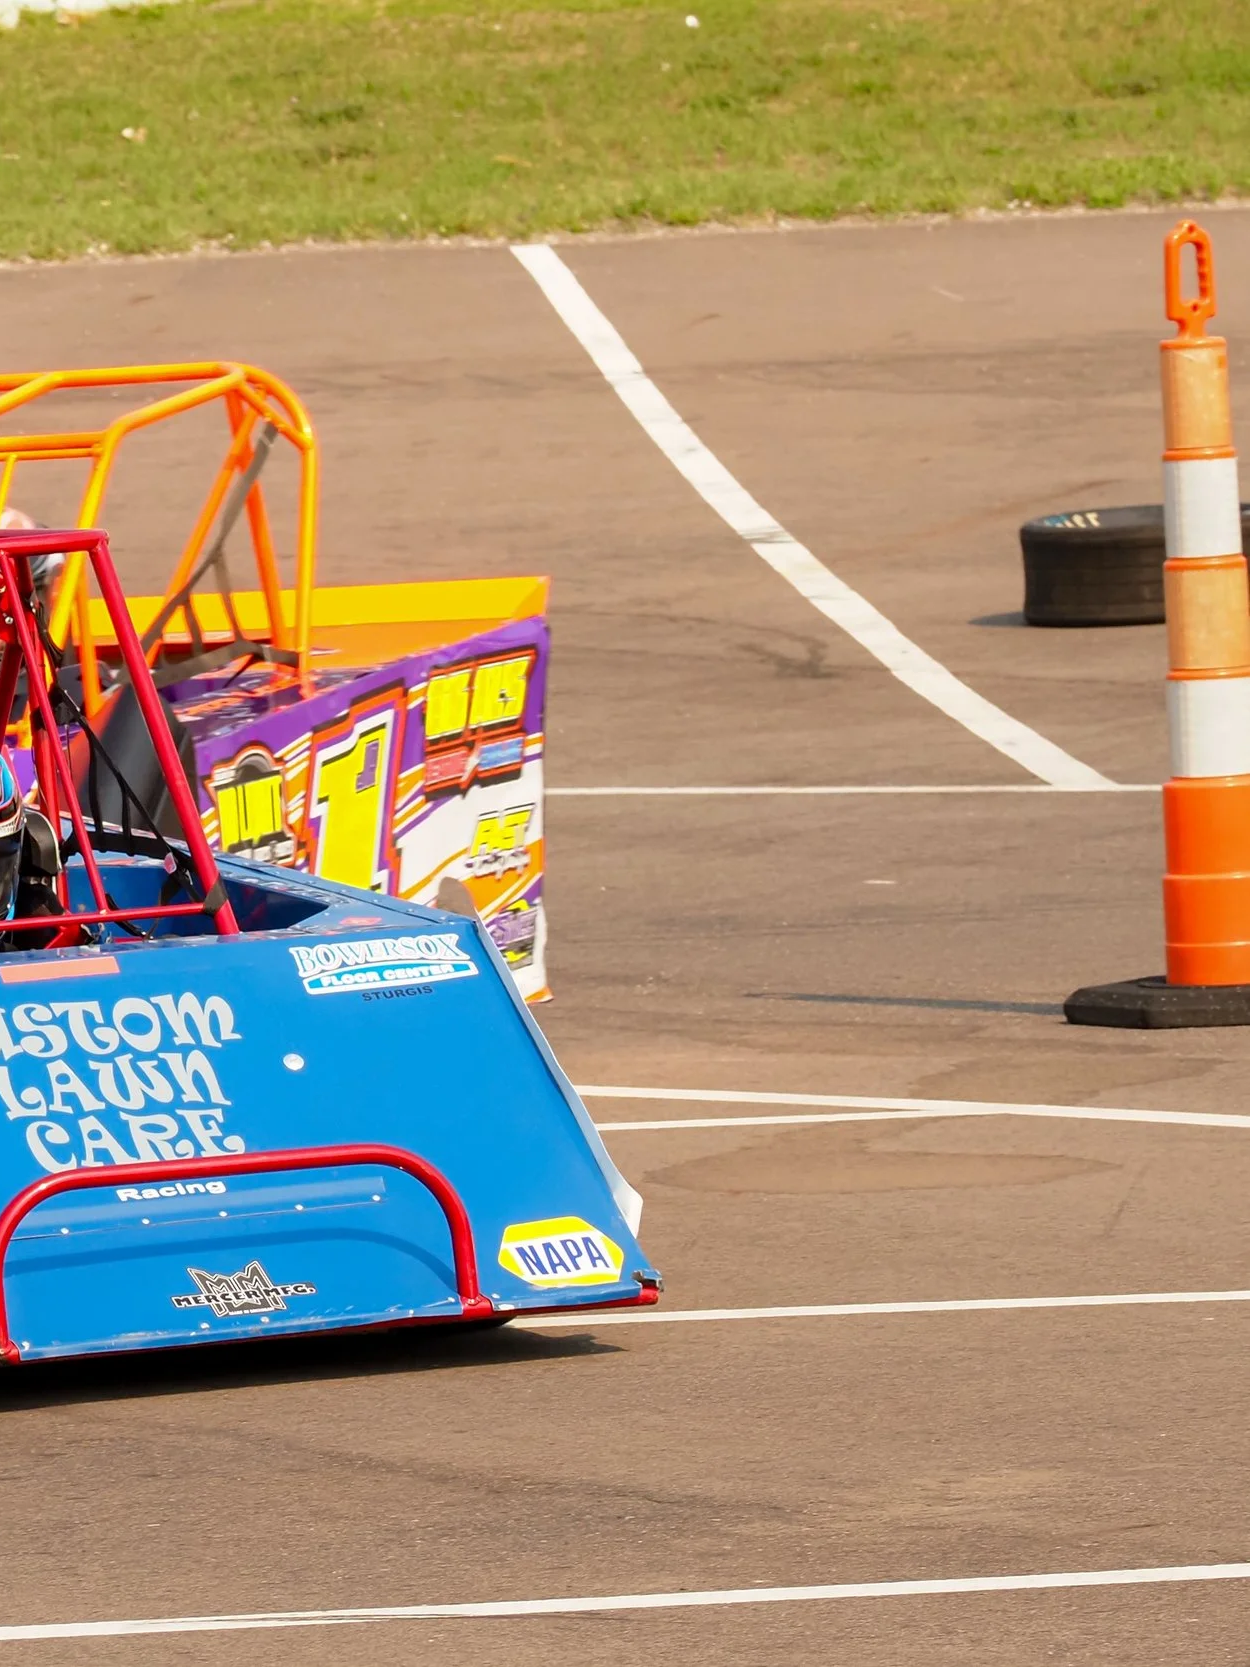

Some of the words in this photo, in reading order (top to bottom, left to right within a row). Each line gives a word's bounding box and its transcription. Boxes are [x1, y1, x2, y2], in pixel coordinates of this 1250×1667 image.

[289, 933, 470, 977] BOWERSOX
[320, 971, 381, 988] FLOOR
[383, 964, 455, 981] CENTER
[362, 985, 433, 1001] STURGIS
[26, 1108, 245, 1174] CARE
[116, 1180, 227, 1202] Racing
[515, 1236, 610, 1276] NAPA
[173, 1289, 262, 1308] MERCER
[263, 1282, 317, 1298] MFG.
